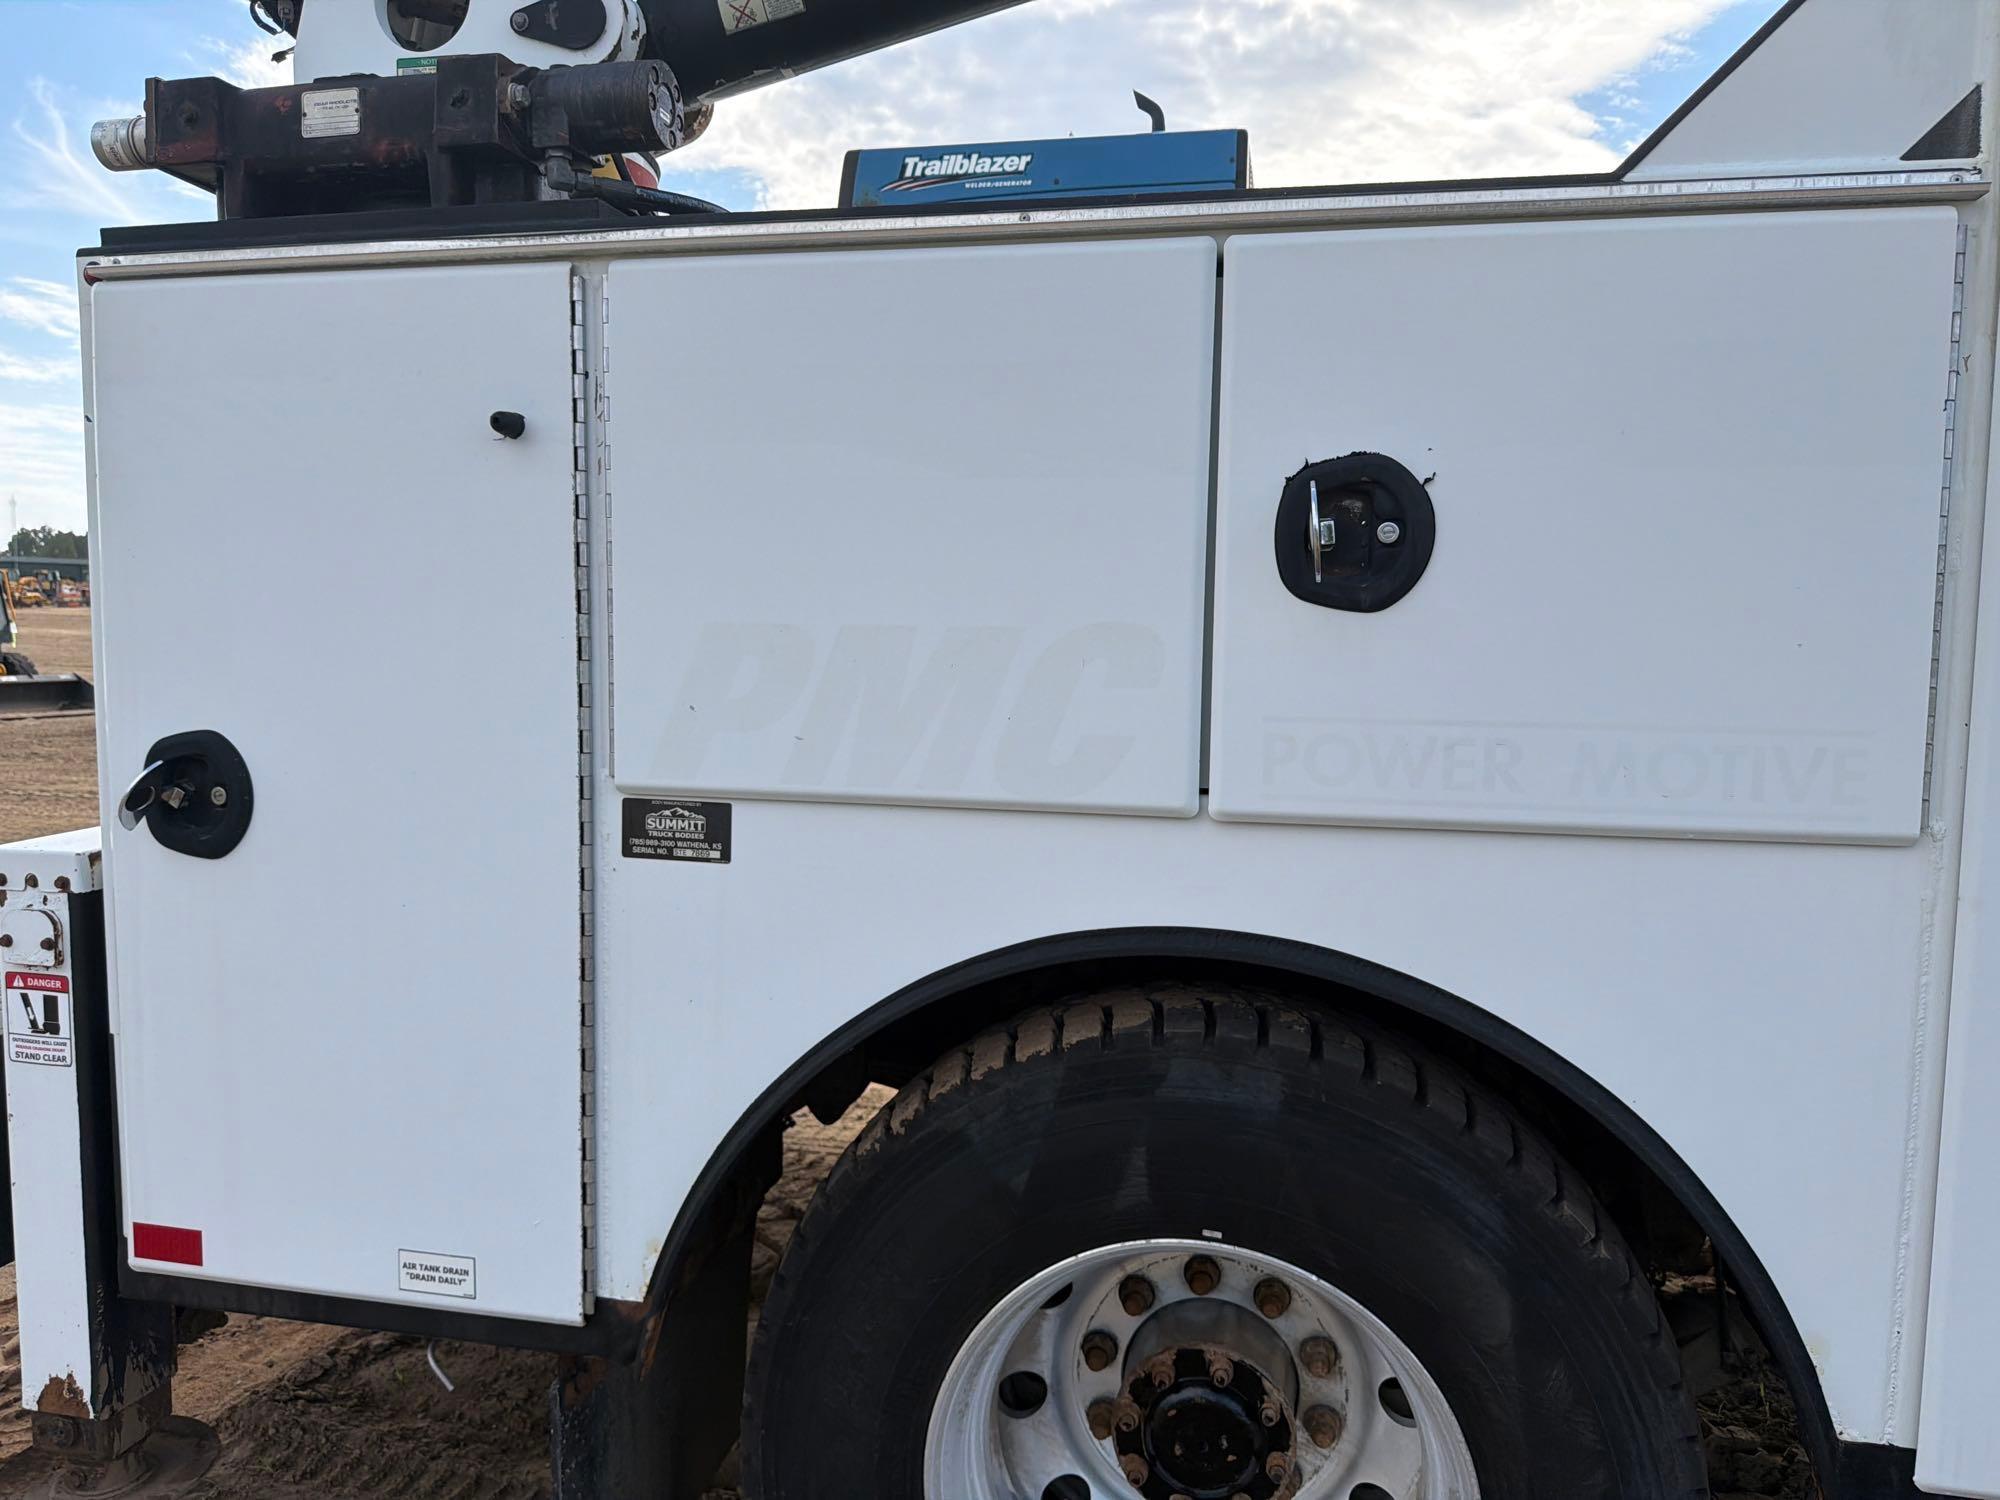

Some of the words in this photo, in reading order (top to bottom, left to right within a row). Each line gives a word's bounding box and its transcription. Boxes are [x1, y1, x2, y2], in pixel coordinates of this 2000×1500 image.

[904, 153, 1032, 177] Trailblazer
[965, 180, 1032, 188] WELDER/GENERATOR
[649, 621, 1165, 796] PMC
[1261, 731, 1525, 793] POWER
[1570, 738, 1870, 804] MOTIVE
[647, 818, 705, 831] SUMMIT
[648, 830, 673, 838] TRUCK
[632, 846, 655, 854] SERIAL
[677, 841, 711, 850] WATHENA,
[27, 978, 62, 988] DANGER
[12, 1037, 40, 1045] OUTRIGGERS
[15, 1051, 41, 1060] STAND
[43, 1054, 67, 1063] CLEAR
[402, 1262, 417, 1270] AIR
[419, 1263, 441, 1273] TANK
[443, 1266, 469, 1277] DRAIN
[406, 1271, 436, 1282] "DRAIN
[438, 1276, 467, 1286] DAILY"
